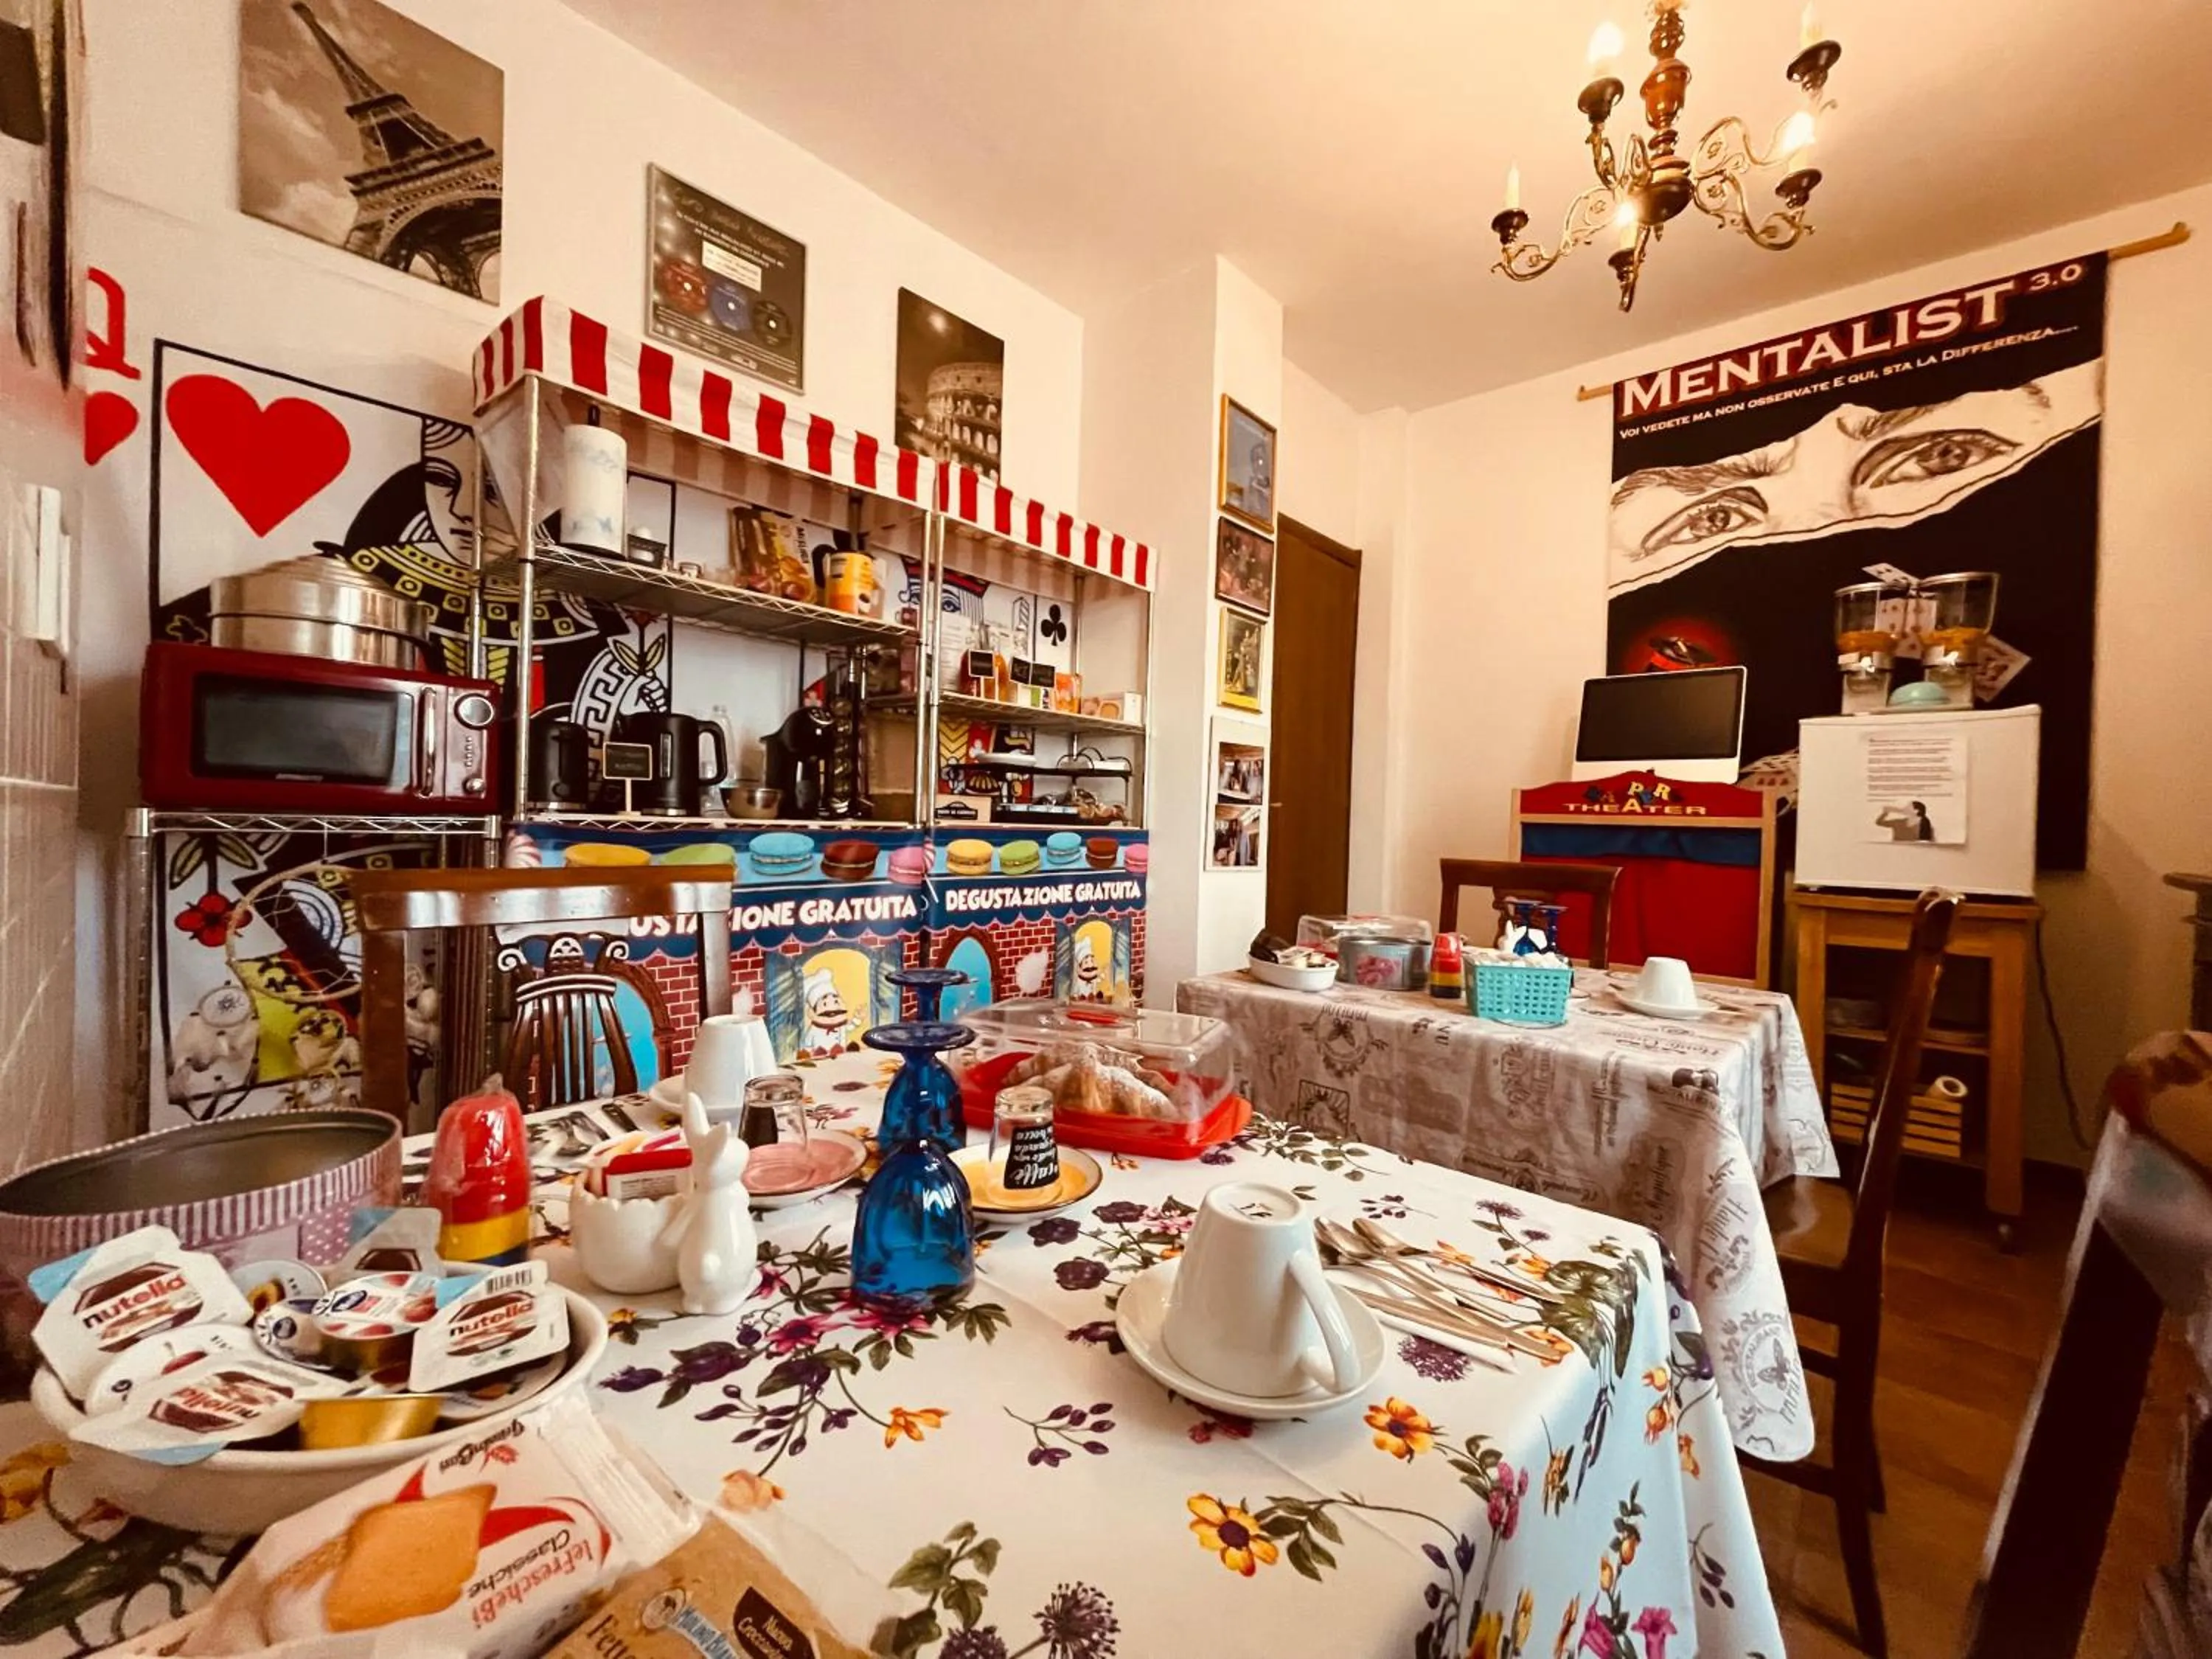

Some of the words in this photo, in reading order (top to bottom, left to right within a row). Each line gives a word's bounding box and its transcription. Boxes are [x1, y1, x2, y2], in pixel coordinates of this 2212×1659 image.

[1623, 279, 2015, 417] MENTALIST
[2029, 263, 2082, 291] 3.0
[1620, 427, 1640, 439] VOI
[1642, 415, 1691, 434] VEDETE
[1693, 410, 1713, 422] MA
[1714, 402, 1745, 417] NON
[1747, 382, 1829, 408] OSSERVATE
[1882, 361, 1913, 375] STA
[1916, 354, 1938, 368] LA
[1563, 798, 1707, 815] THEATER
[800, 894, 917, 925] GRATUITA
[945, 886, 1074, 911] DEGUSTAZIONE
[1075, 881, 1141, 902] GRATUITA
[83, 1275, 187, 1328] nutella
[450, 1299, 534, 1337] nutella
[171, 1385, 262, 1420] nutella
[467, 1528, 570, 1599] Classiche
